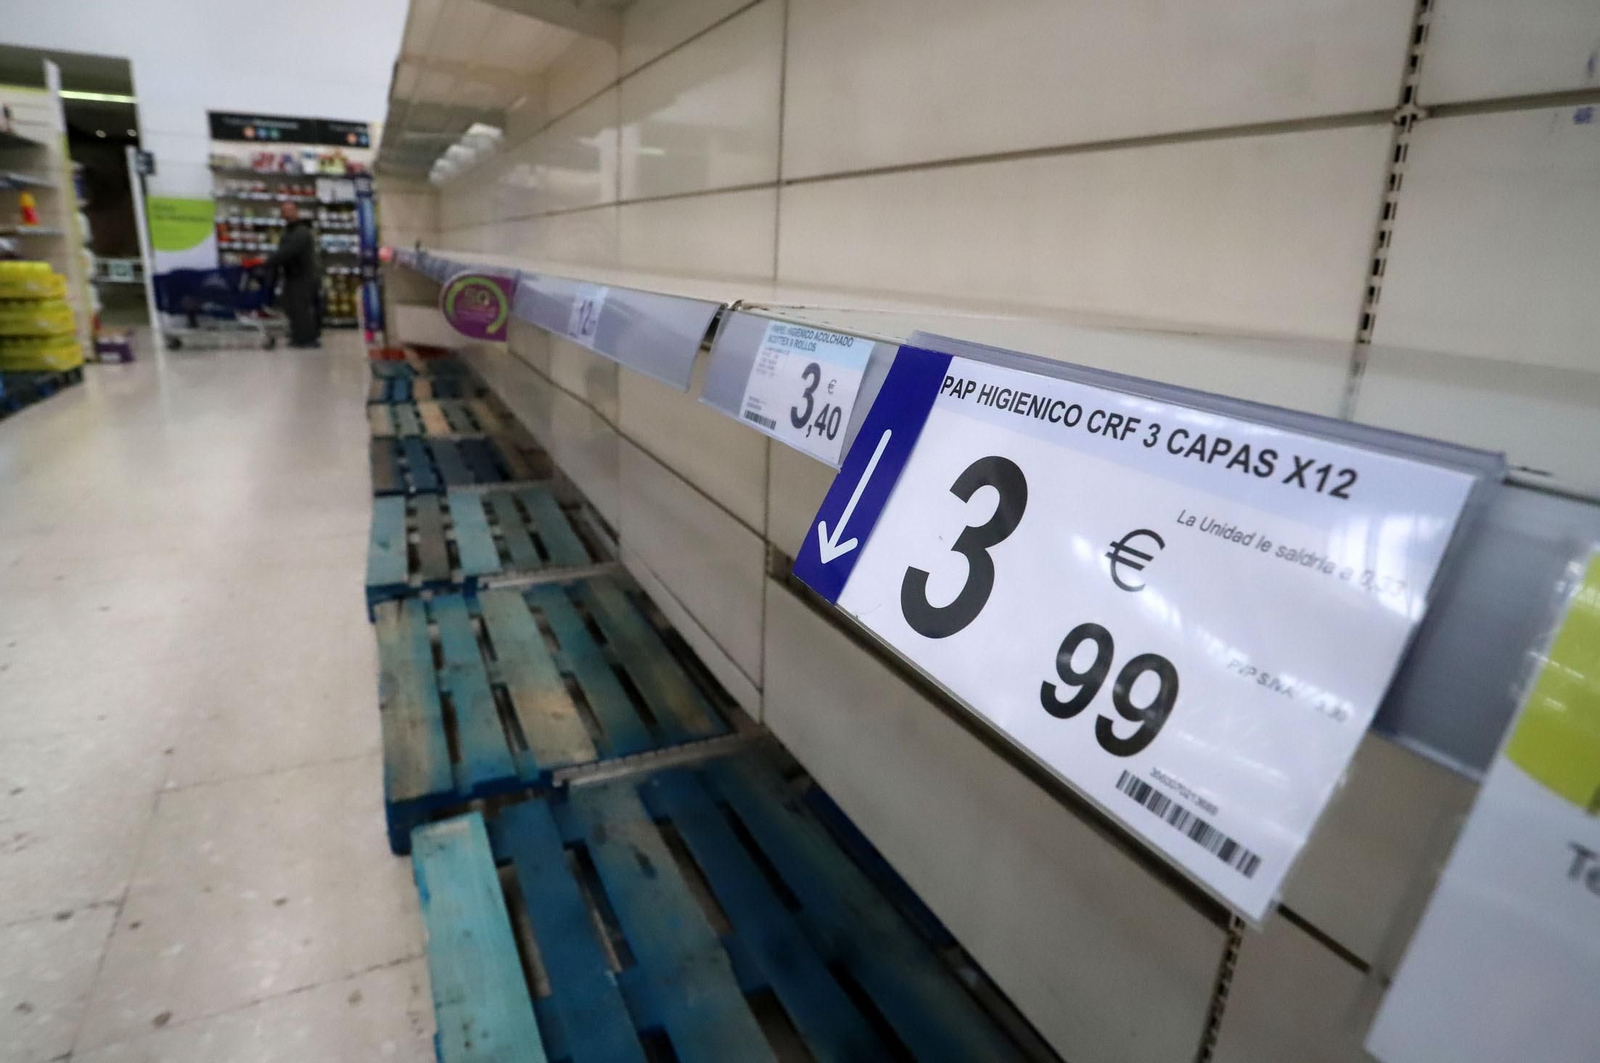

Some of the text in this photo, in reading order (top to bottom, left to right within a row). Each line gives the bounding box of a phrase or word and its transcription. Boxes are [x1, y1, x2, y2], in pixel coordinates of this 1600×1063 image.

[794, 340, 817, 352] ROLLOS
[814, 332, 854, 347] ACOLCHADO
[827, 379, 837, 394] €
[940, 375, 1358, 500] PAP HIGIENICO CRF 3 CAPAS X12
[900, 455, 1028, 639] 3
[1176, 509, 1196, 527] La
[1199, 516, 1257, 546] Unidad
[1255, 535, 1272, 552] le
[1104, 528, 1165, 592] €
[1040, 622, 1179, 757] 99
